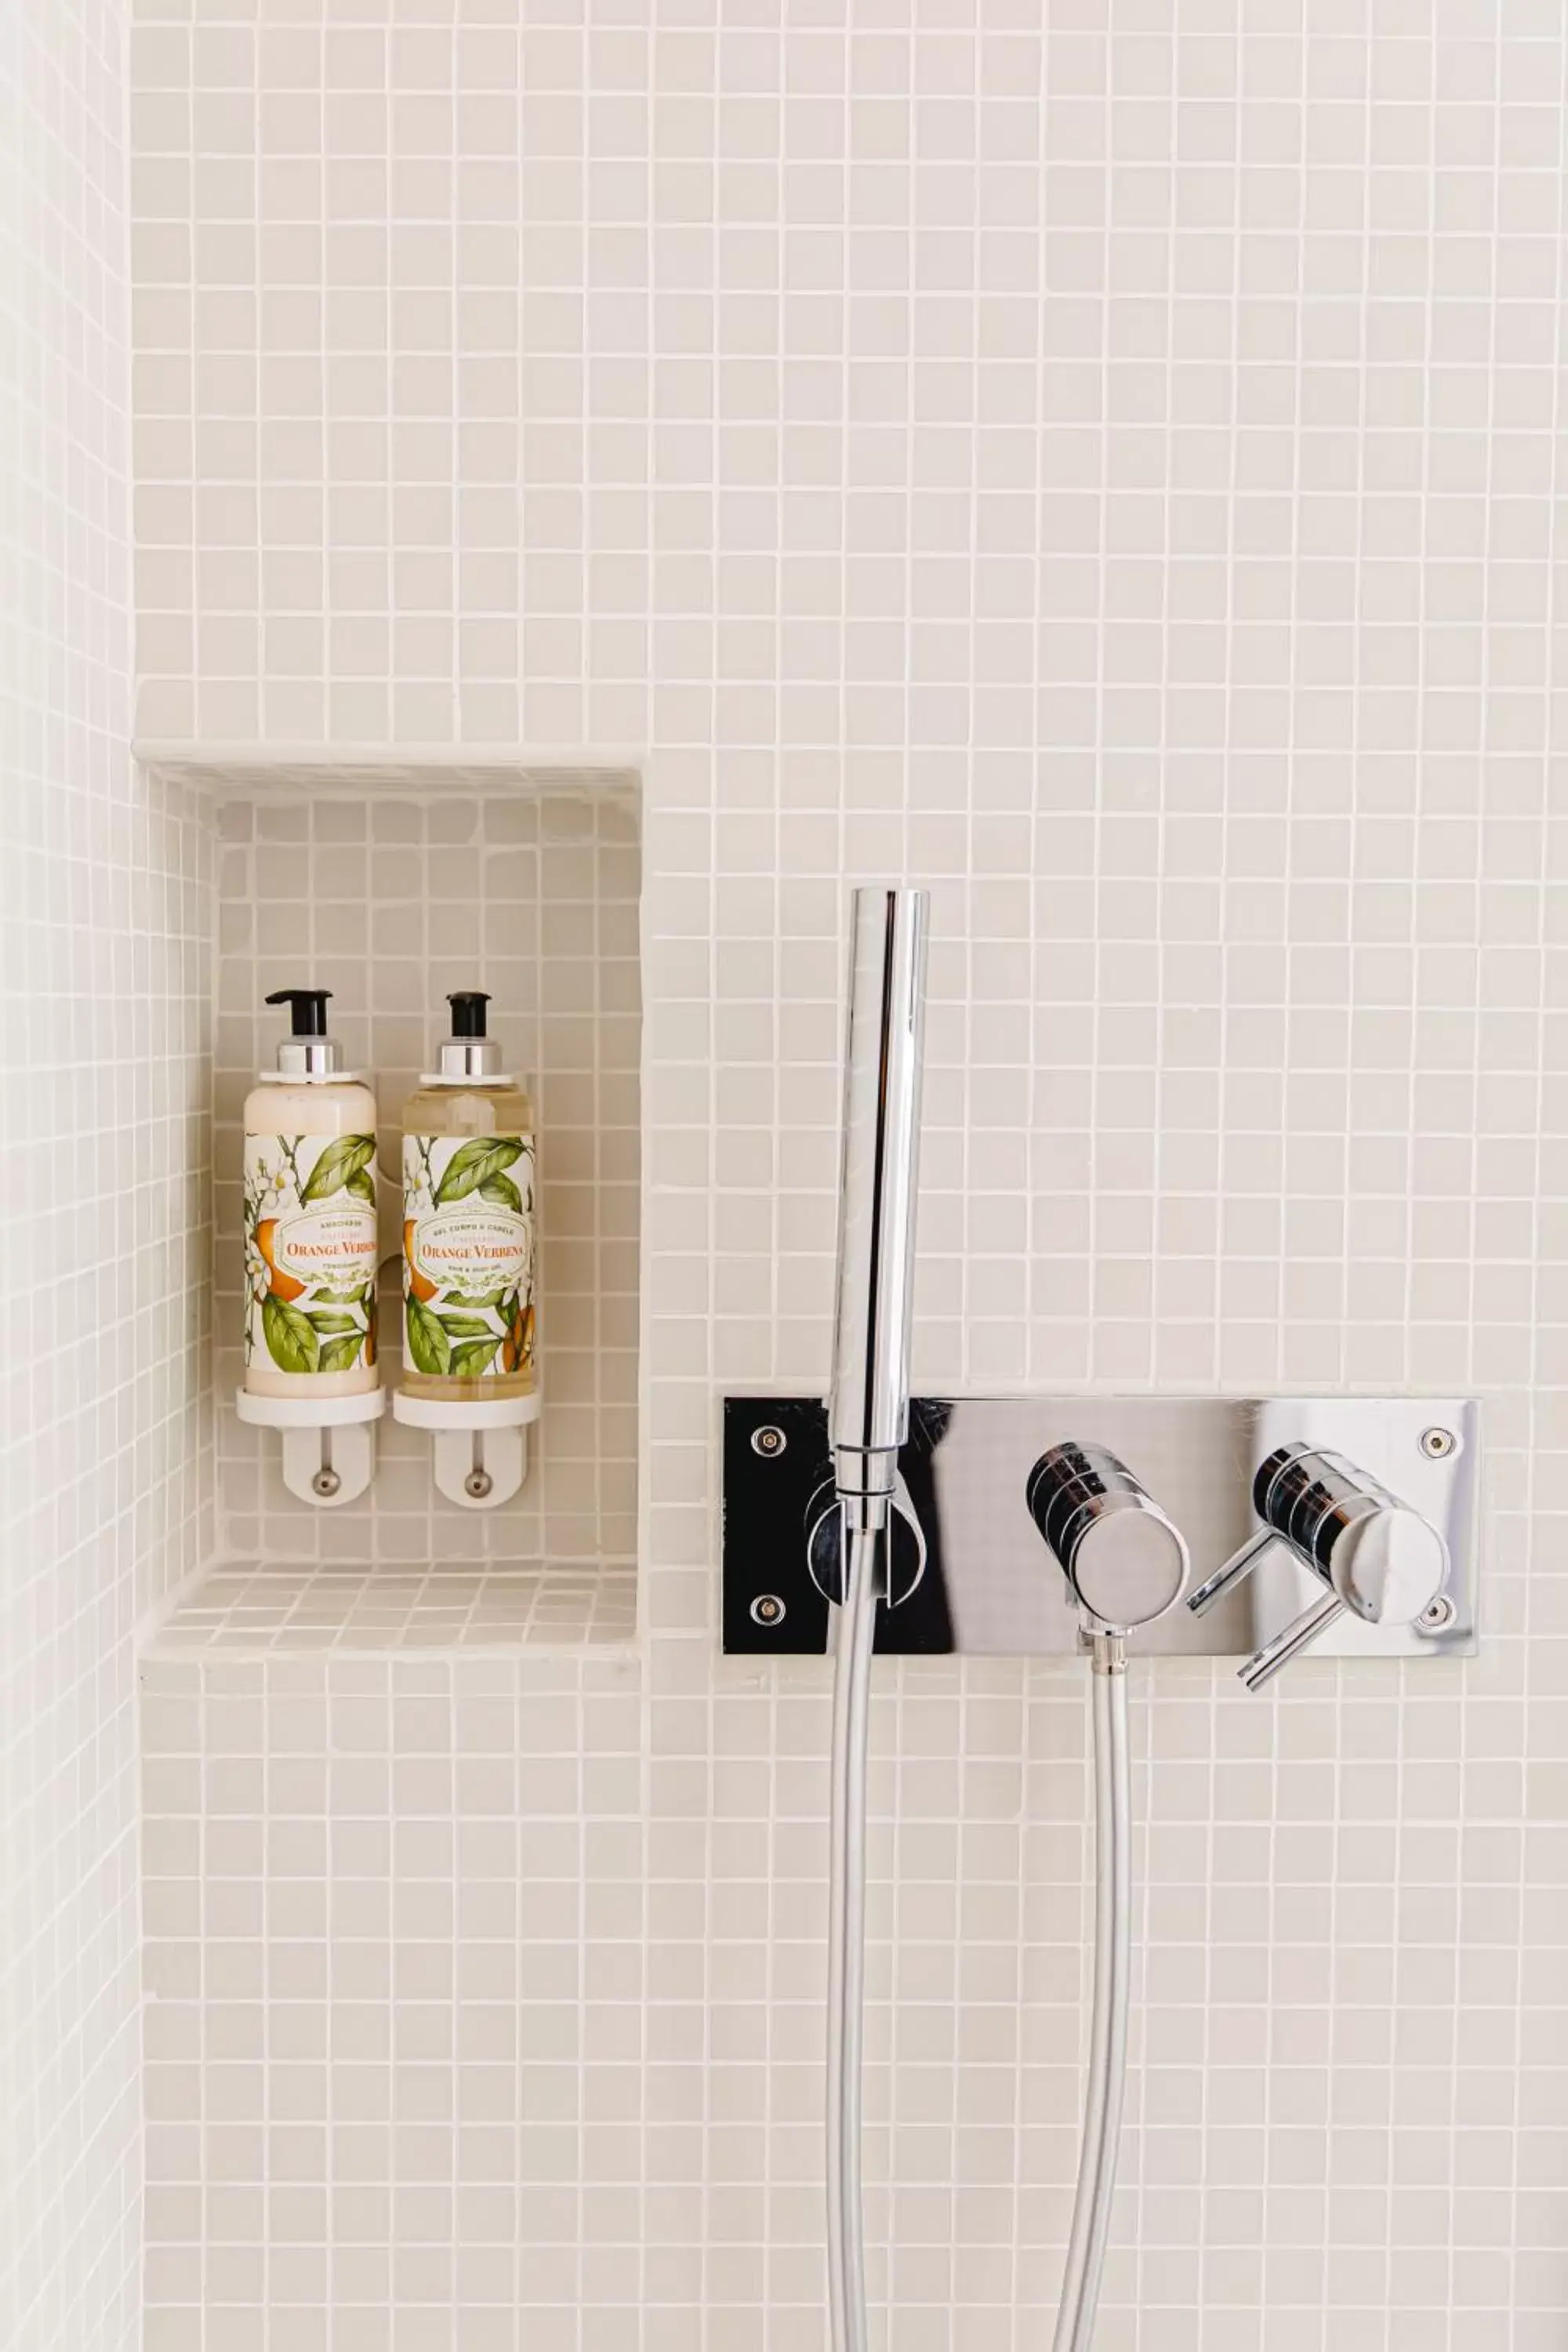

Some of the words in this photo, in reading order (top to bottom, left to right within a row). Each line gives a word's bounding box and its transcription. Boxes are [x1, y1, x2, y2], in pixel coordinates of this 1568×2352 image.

[287, 1243, 340, 1256] ORANGE
[422, 1244, 471, 1258] ORANGE
[474, 1244, 523, 1258] VERBENA
